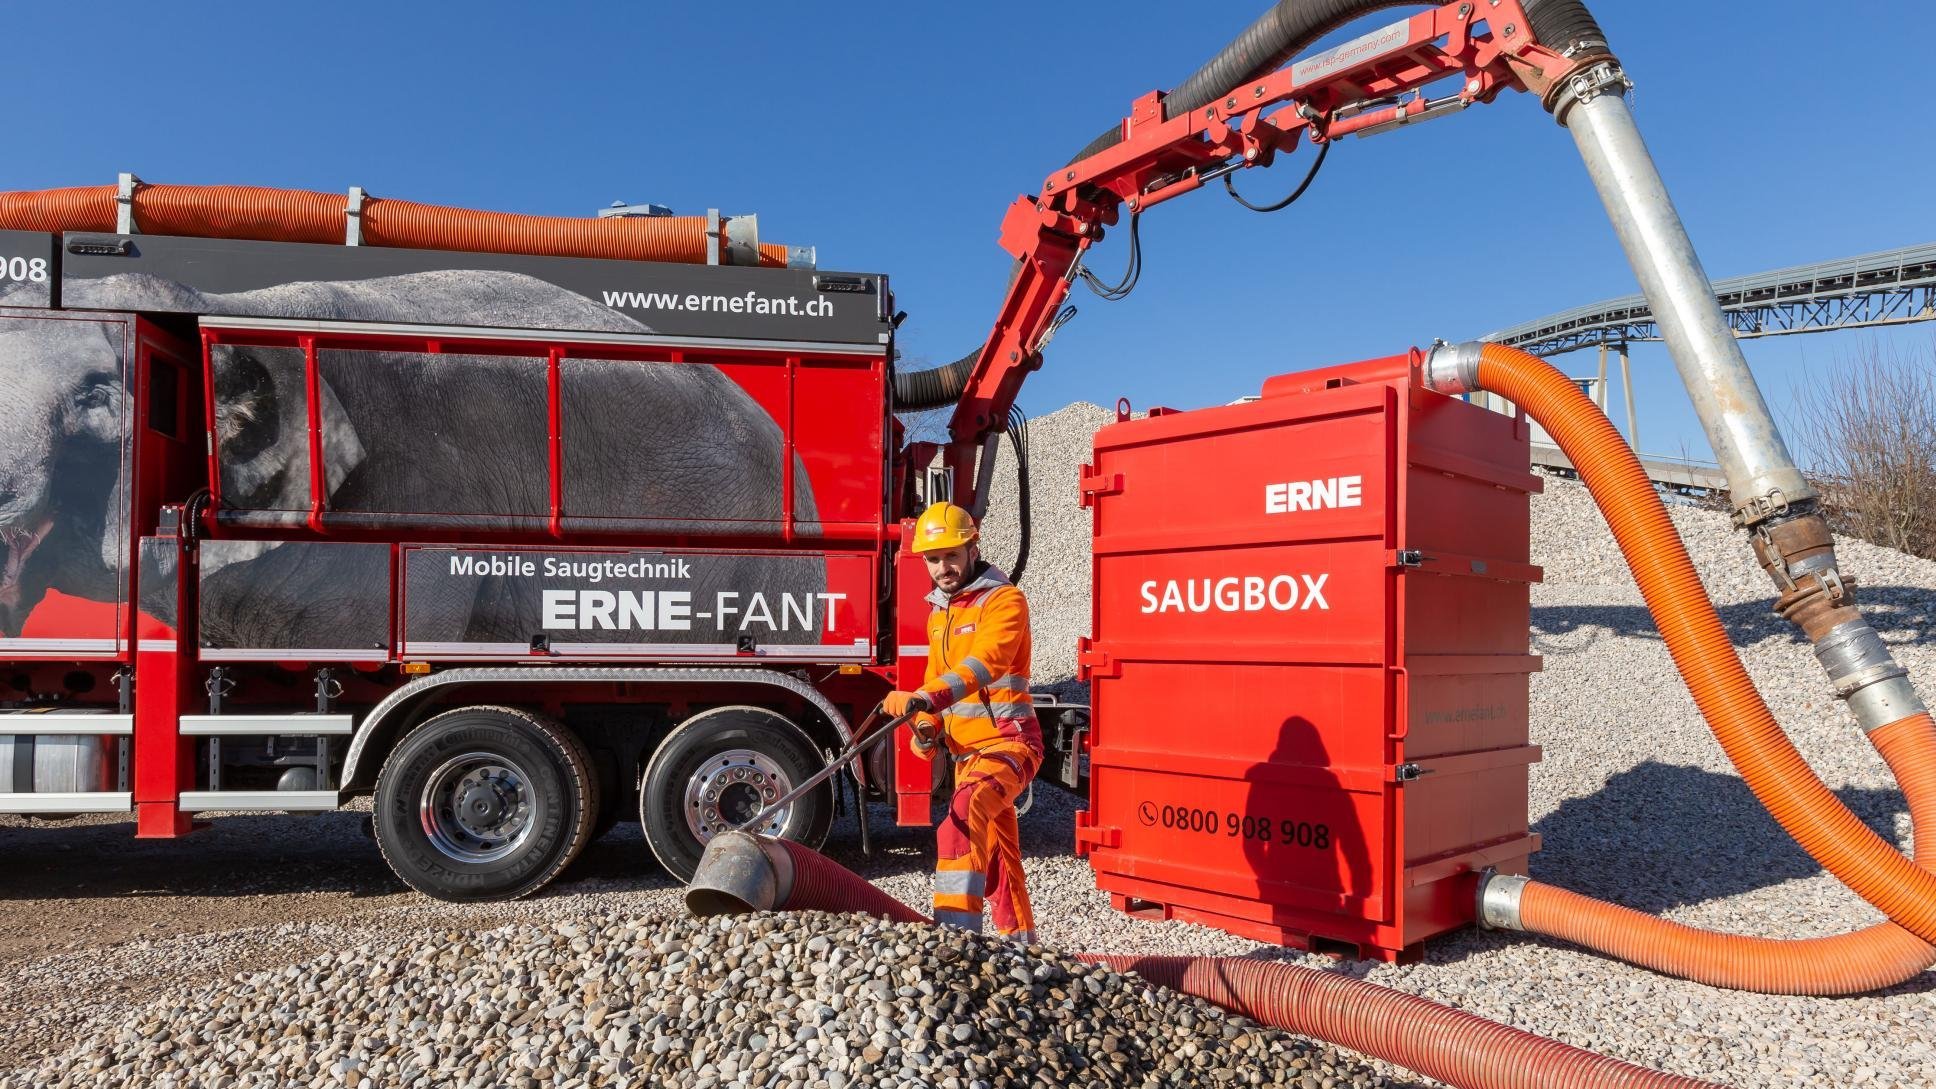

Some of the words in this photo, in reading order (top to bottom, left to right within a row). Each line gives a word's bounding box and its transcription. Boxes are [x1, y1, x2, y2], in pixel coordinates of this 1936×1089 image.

[1299, 29, 1402, 77] www.rsp-germany.com
[602, 290, 834, 317] www.ernefant.ch
[1265, 475, 1362, 514] ERNE
[450, 556, 536, 576] Mobile
[543, 558, 692, 583] Saugtechnik
[542, 589, 847, 632] ERNE-FANT
[1140, 573, 1330, 614] SAUGBOX
[1162, 805, 1219, 834] 0800
[1226, 813, 1272, 842] 908
[1280, 820, 1330, 850] 908
